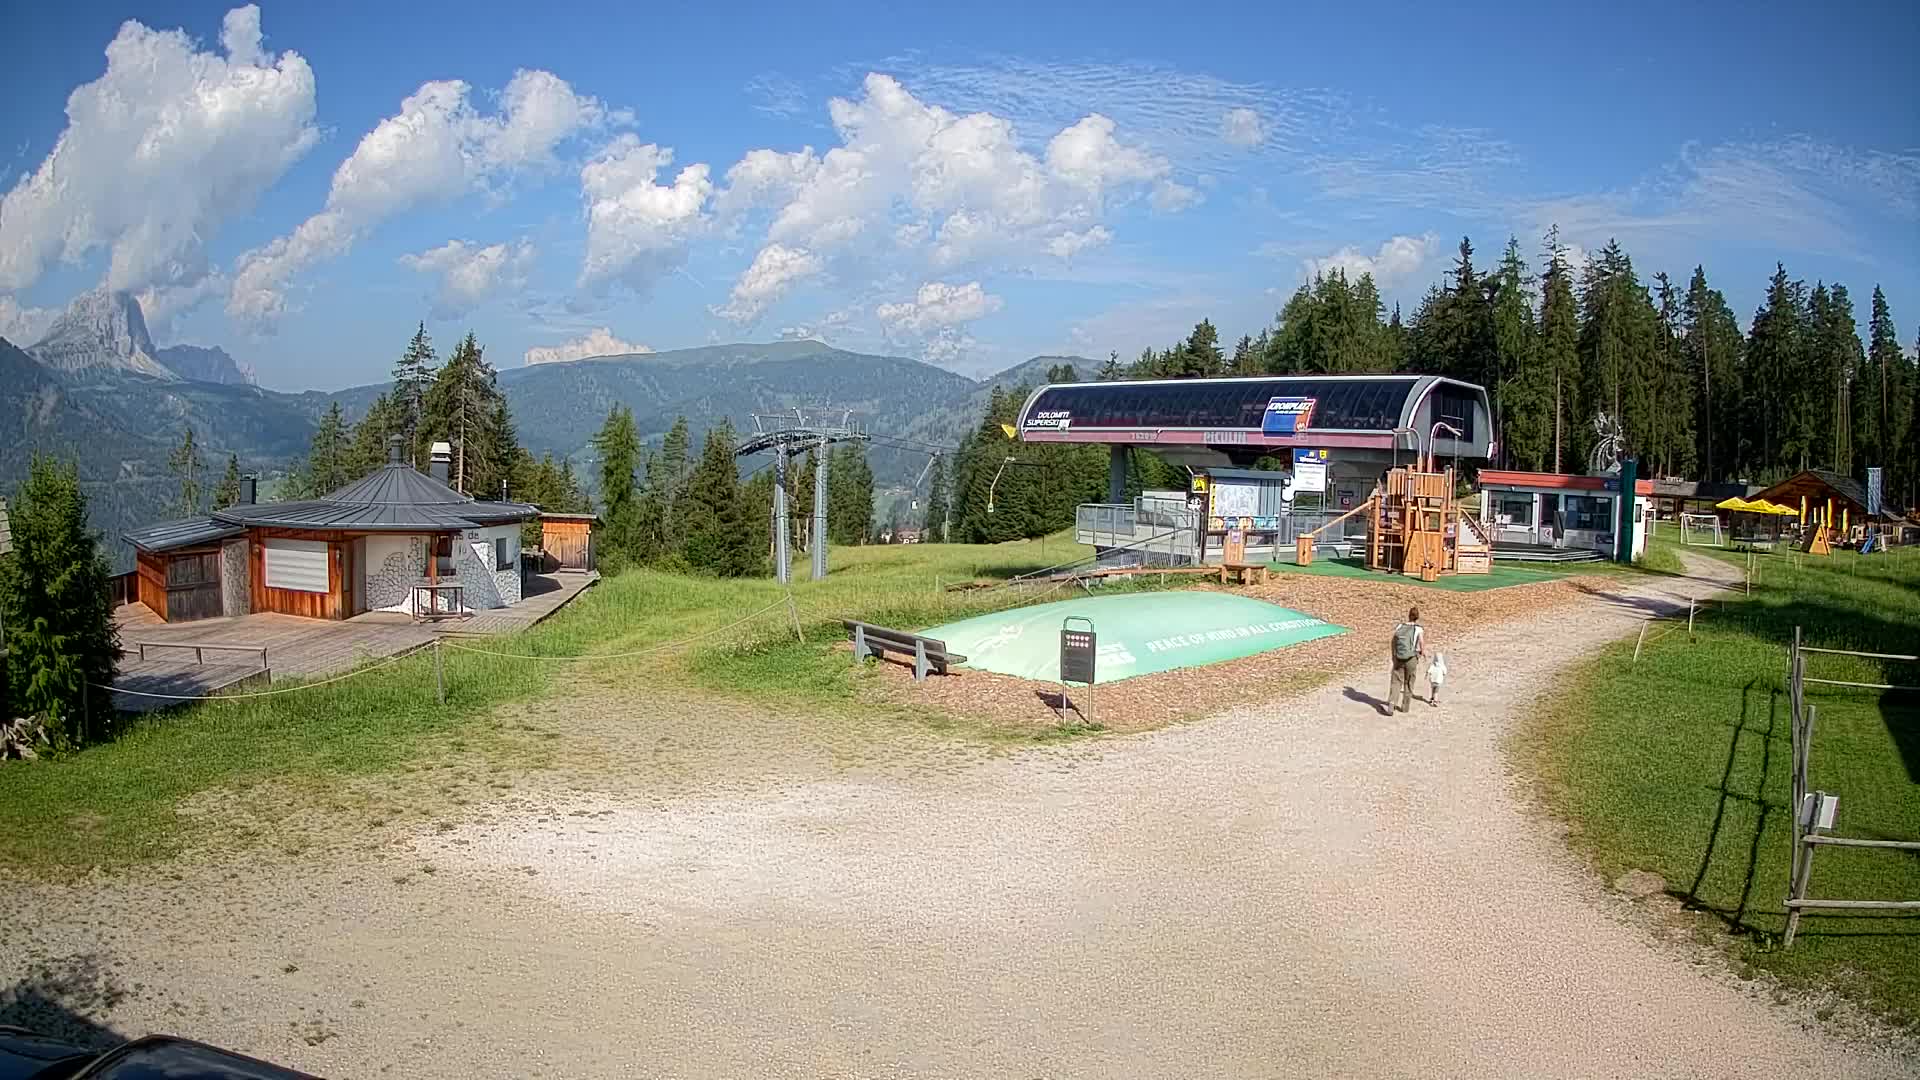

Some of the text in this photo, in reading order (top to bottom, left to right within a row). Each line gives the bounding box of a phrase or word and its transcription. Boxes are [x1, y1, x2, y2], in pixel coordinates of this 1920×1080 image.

[1037, 411, 1070, 419] DOLOMITI
[1145, 635, 1188, 652] PEACE
[1189, 631, 1206, 645] OF
[1205, 627, 1236, 642] MIND
[1249, 623, 1270, 635] ALL
